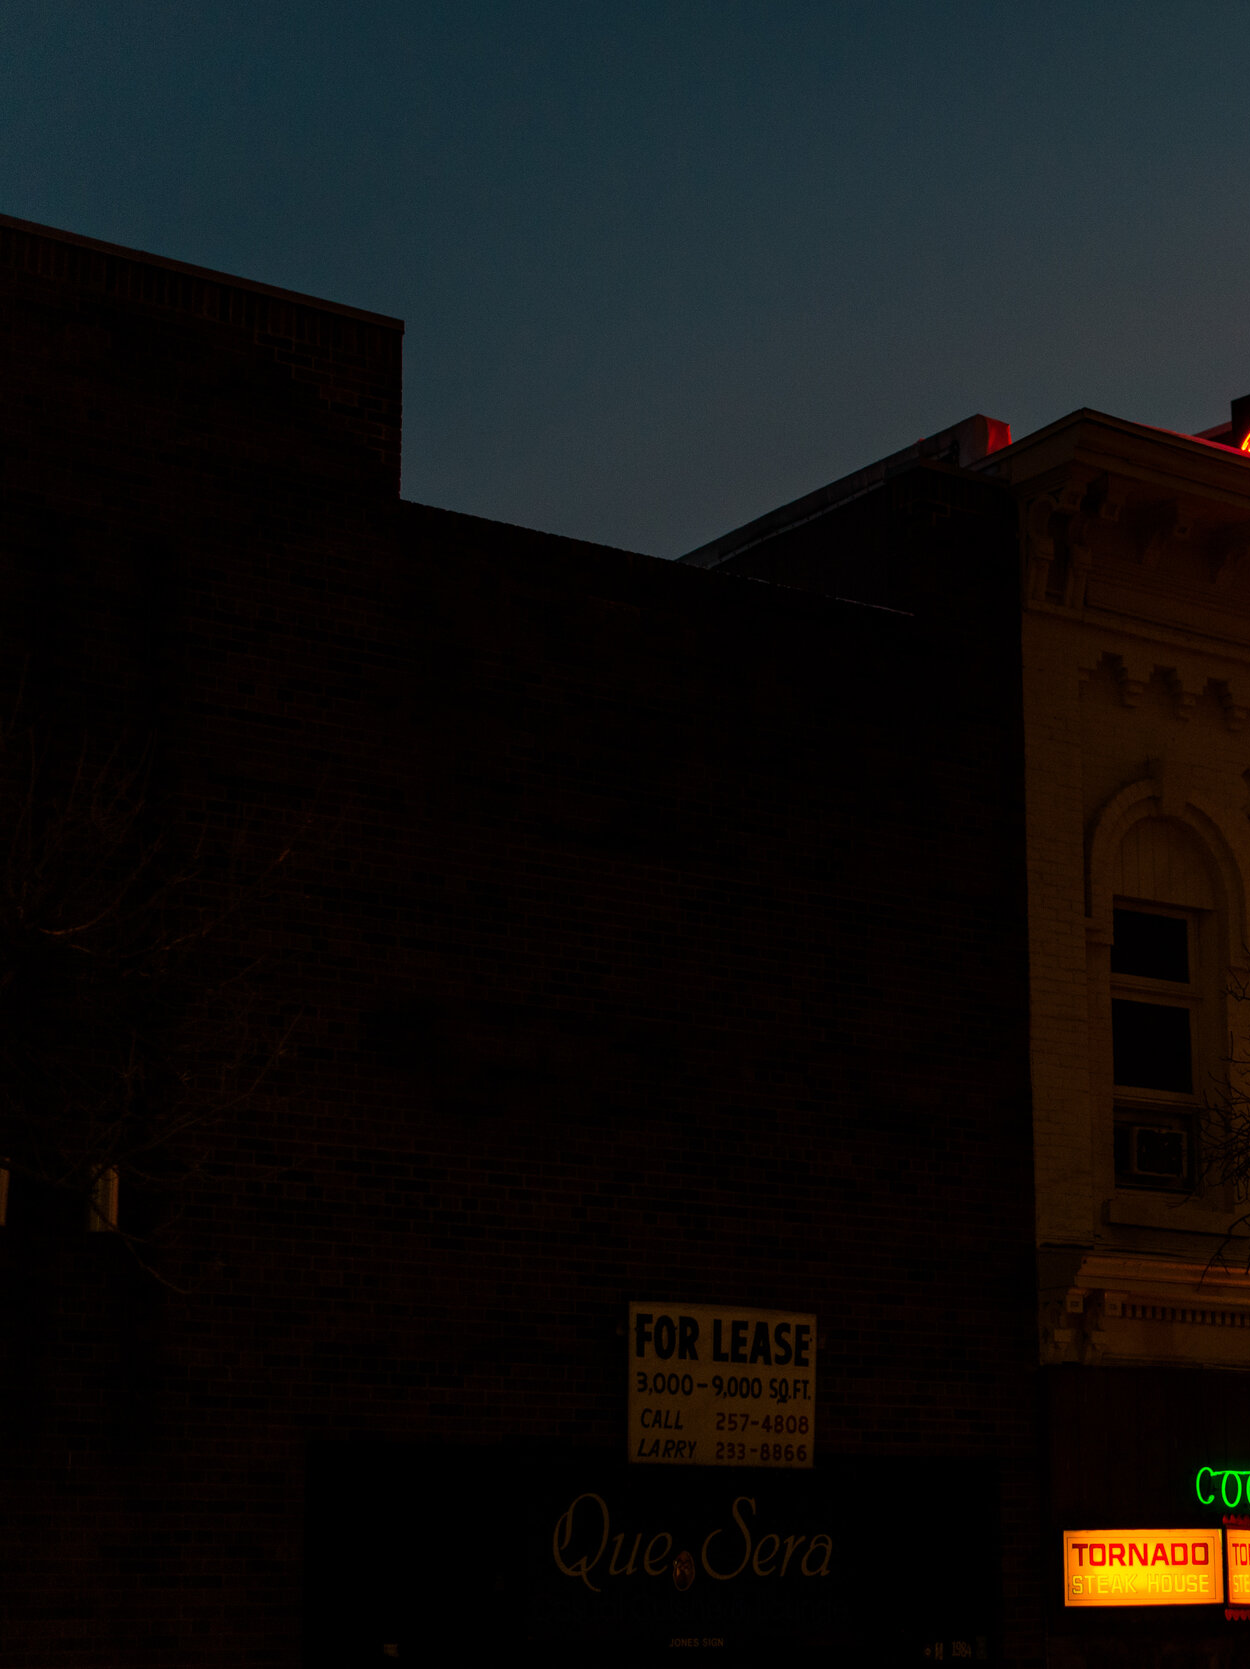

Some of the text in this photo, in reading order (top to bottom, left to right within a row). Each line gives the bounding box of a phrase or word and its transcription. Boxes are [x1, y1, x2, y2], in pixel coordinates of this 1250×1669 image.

[636, 1314, 811, 1367] FOR LEASE
[641, 1409, 810, 1434] CALL 257-4808
[637, 1439, 808, 1462] LARRY 233-8866
[553, 1493, 833, 1592] Que Sera
[1072, 1543, 1209, 1567] TORNADO
[1072, 1574, 1210, 1595] STEAK HOUSE
[669, 1638, 724, 1648] JONES SIGN
